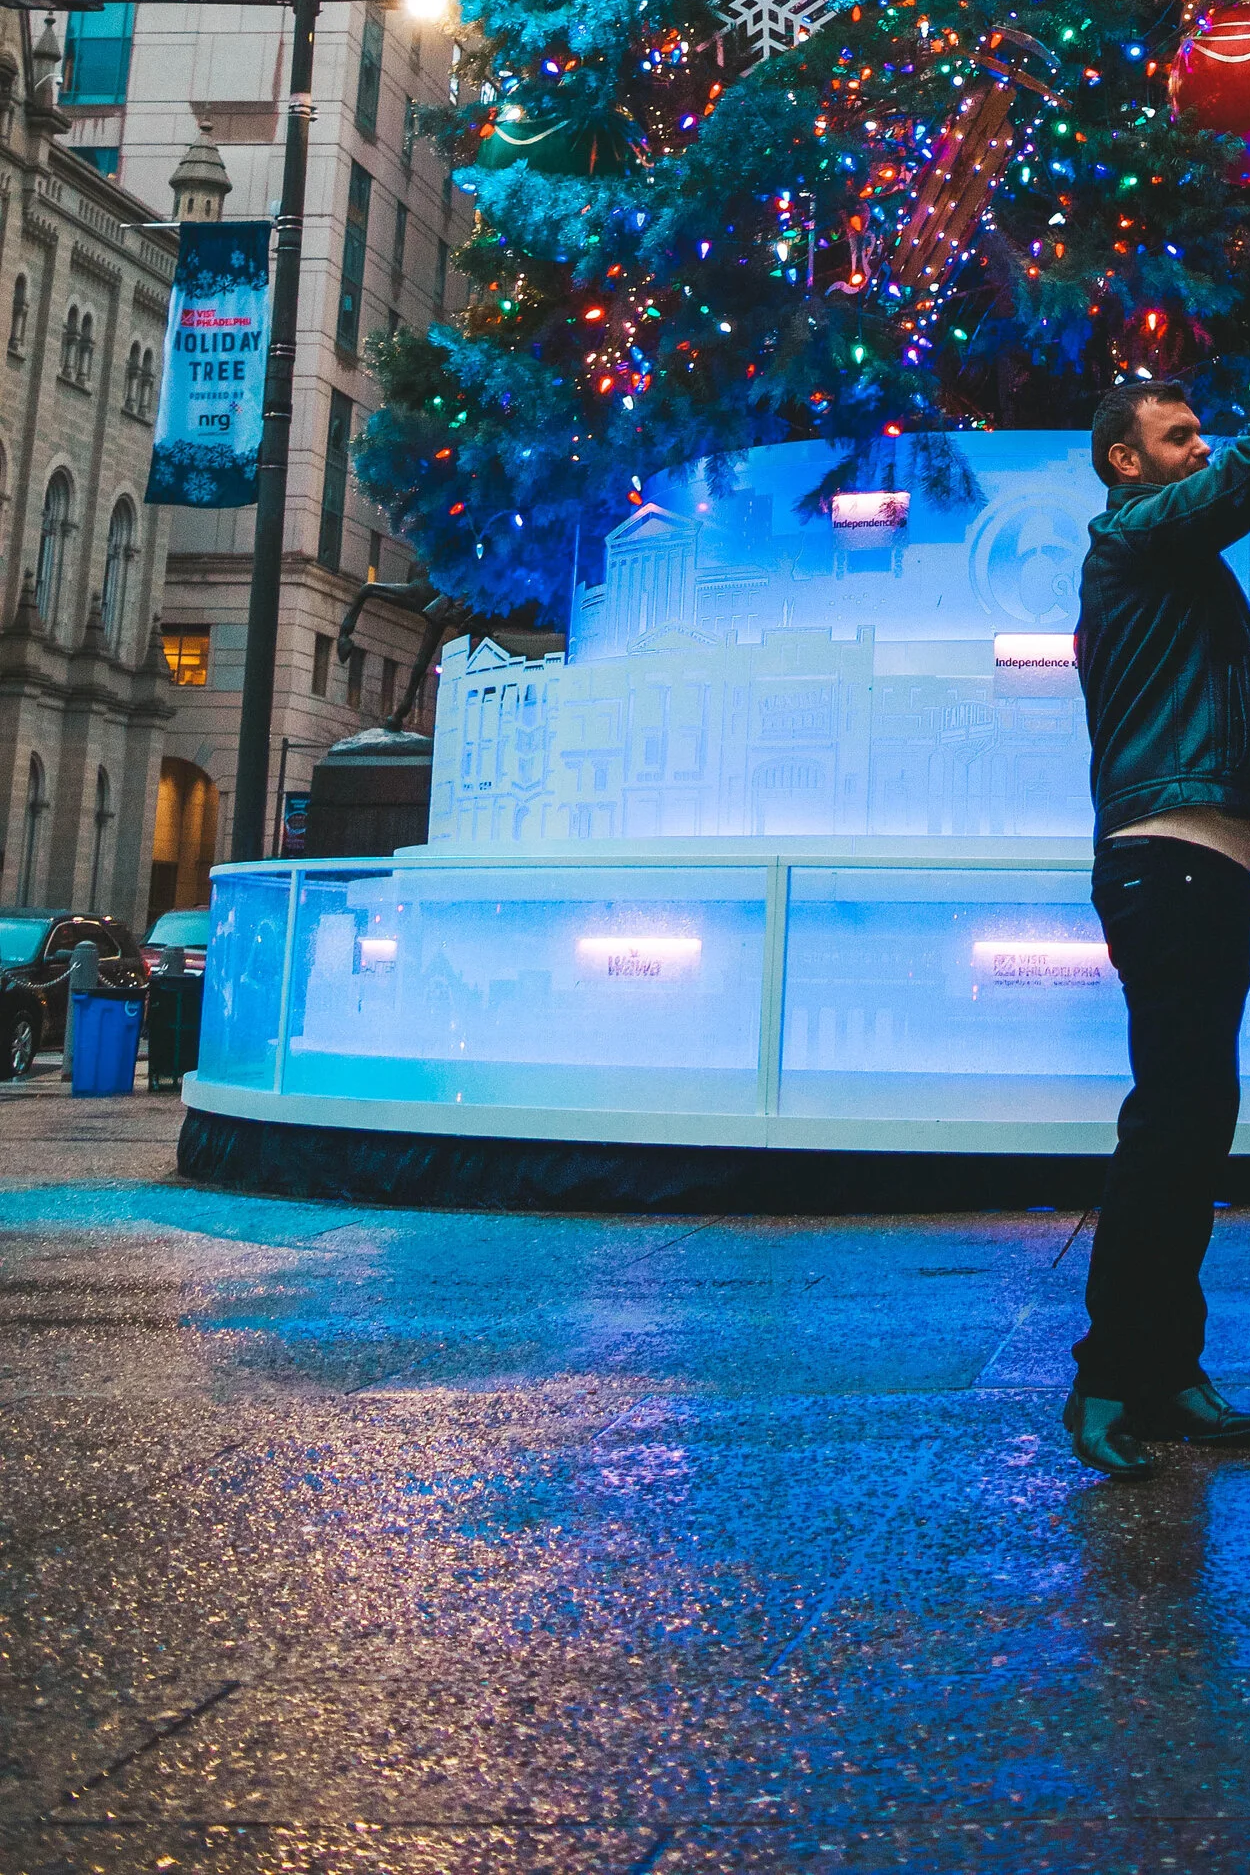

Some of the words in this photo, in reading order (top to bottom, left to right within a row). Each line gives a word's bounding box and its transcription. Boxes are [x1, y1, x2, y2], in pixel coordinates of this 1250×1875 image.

[189, 360, 245, 381] TREE
[189, 391, 229, 400] POWERED
[233, 390, 244, 400] BY
[199, 413, 231, 431] nrg
[995, 657, 1070, 669] Independence
[608, 955, 662, 976] Wawa
[1019, 954, 1048, 965] VISIT
[1018, 966, 1102, 978] PHILADELPHIA
